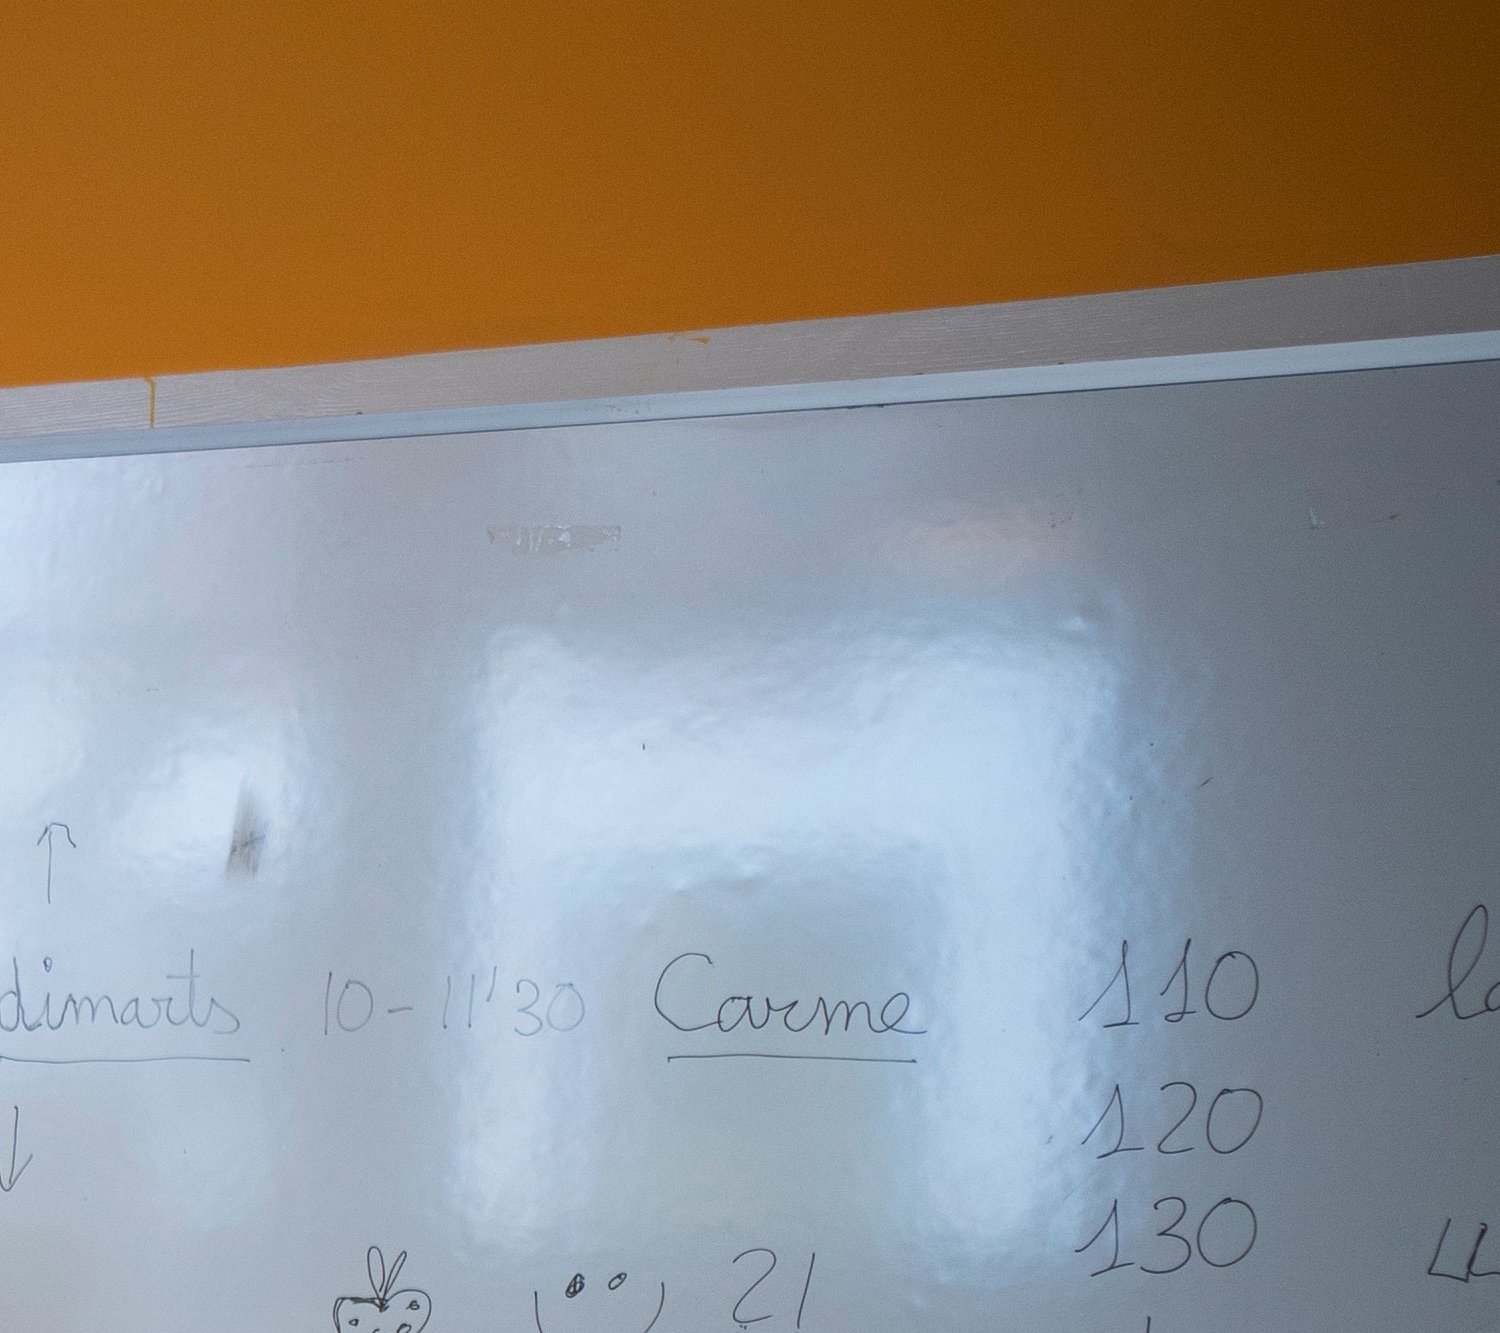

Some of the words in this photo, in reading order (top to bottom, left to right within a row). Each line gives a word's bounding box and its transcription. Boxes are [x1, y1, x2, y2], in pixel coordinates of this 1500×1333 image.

[654, 951, 928, 1038] Carme
[1078, 938, 1260, 1027] 110
[1082, 1081, 1264, 1160] 120
[1074, 1196, 1258, 1277] 130
[732, 1248, 817, 1330] 21
